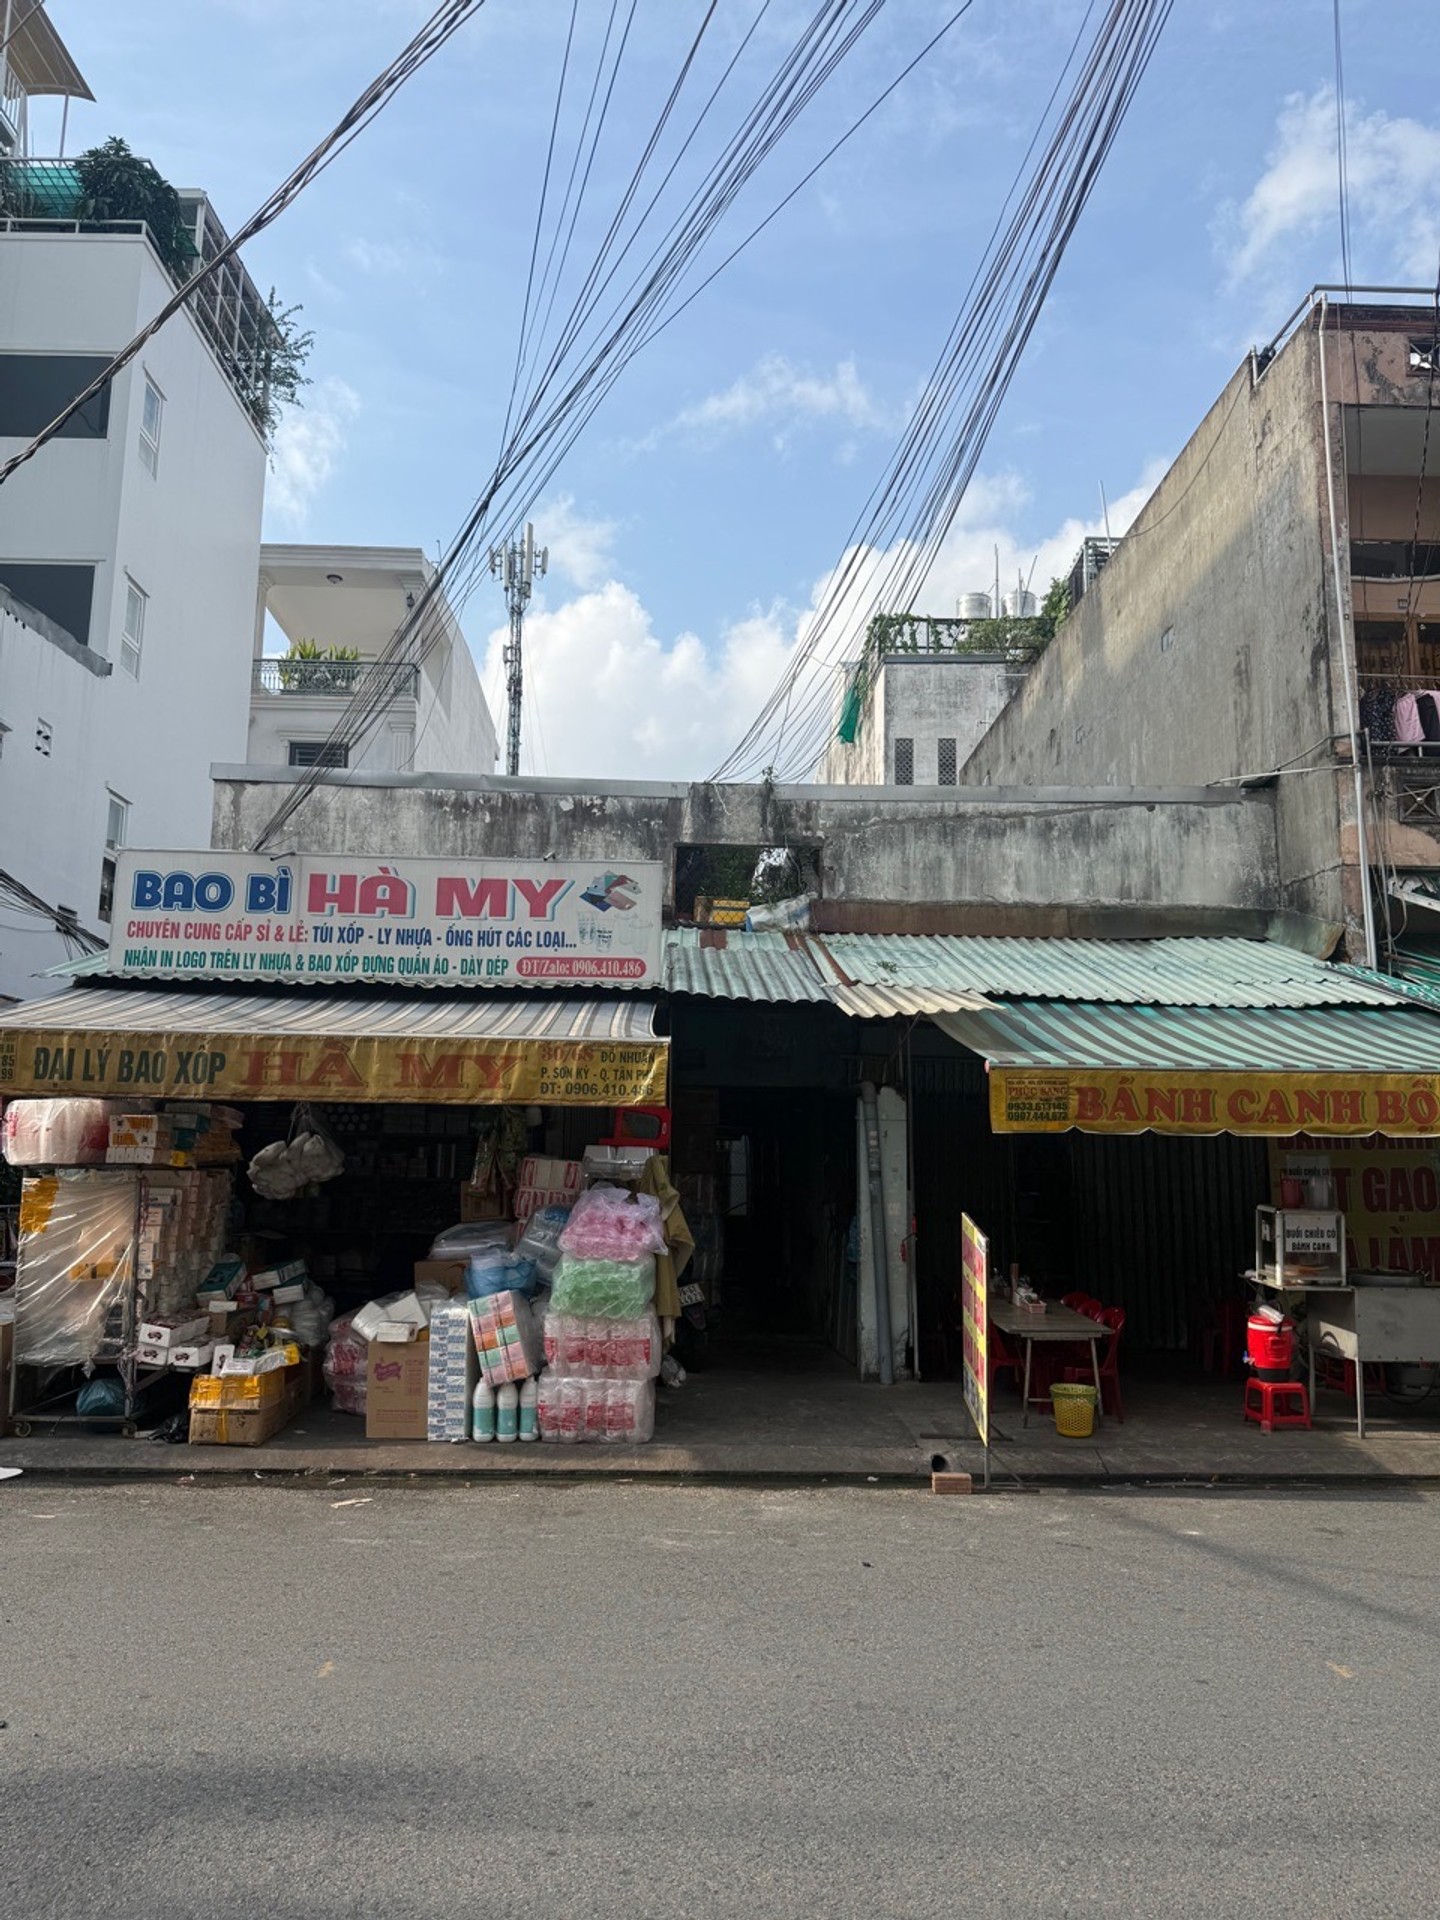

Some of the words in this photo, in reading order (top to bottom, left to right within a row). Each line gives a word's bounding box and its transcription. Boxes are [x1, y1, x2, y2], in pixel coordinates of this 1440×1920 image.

[131, 869, 235, 912] BAO
[245, 865, 293, 914] BÌ
[307, 866, 416, 919] HÀ
[435, 877, 574, 920] MY
[127, 918, 181, 939] CHUYÊN
[184, 922, 221, 940] CUNG
[224, 917, 252, 942] CẤP
[256, 918, 272, 942] SỈ
[274, 926, 284, 942] &
[288, 919, 309, 943] LẺ:
[312, 922, 333, 944] TÚI
[336, 920, 365, 945] XỐP
[377, 928, 393, 945] LY
[396, 927, 433, 950] NHỰA
[446, 923, 473, 946] ỐNG
[477, 924, 503, 947] HÚT
[506, 925, 532, 948] CÁC
[536, 930, 577, 951] LOẠI...
[124, 946, 156, 971] NHẬN
[160, 950, 172, 968] IN
[176, 951, 207, 969] LOGO
[210, 949, 240, 970] TRÊN
[243, 953, 257, 970] LY
[259, 953, 292, 974] NHỰA
[295, 954, 304, 971] &
[307, 954, 332, 972] BAO
[335, 949, 359, 973] XỐP
[433, 954, 449, 975] ÁO
[460, 955, 484, 976] DÀY
[571, 959, 642, 976] 0906.410.486
[82, 1041, 112, 1082] LÝ
[116, 1049, 167, 1084] BAO
[173, 1040, 227, 1085] XỐP
[239, 1040, 368, 1089] HÀ
[393, 1052, 528, 1090] MY
[540, 1067, 550, 1079] P.
[600, 1068, 610, 1082] Q.
[613, 1065, 633, 1081] TÂN
[636, 1068, 656, 1081] PH
[540, 1082, 561, 1094] ĐT:
[1075, 1076, 1217, 1124] BÁNH
[1226, 1088, 1367, 1125] CANH
